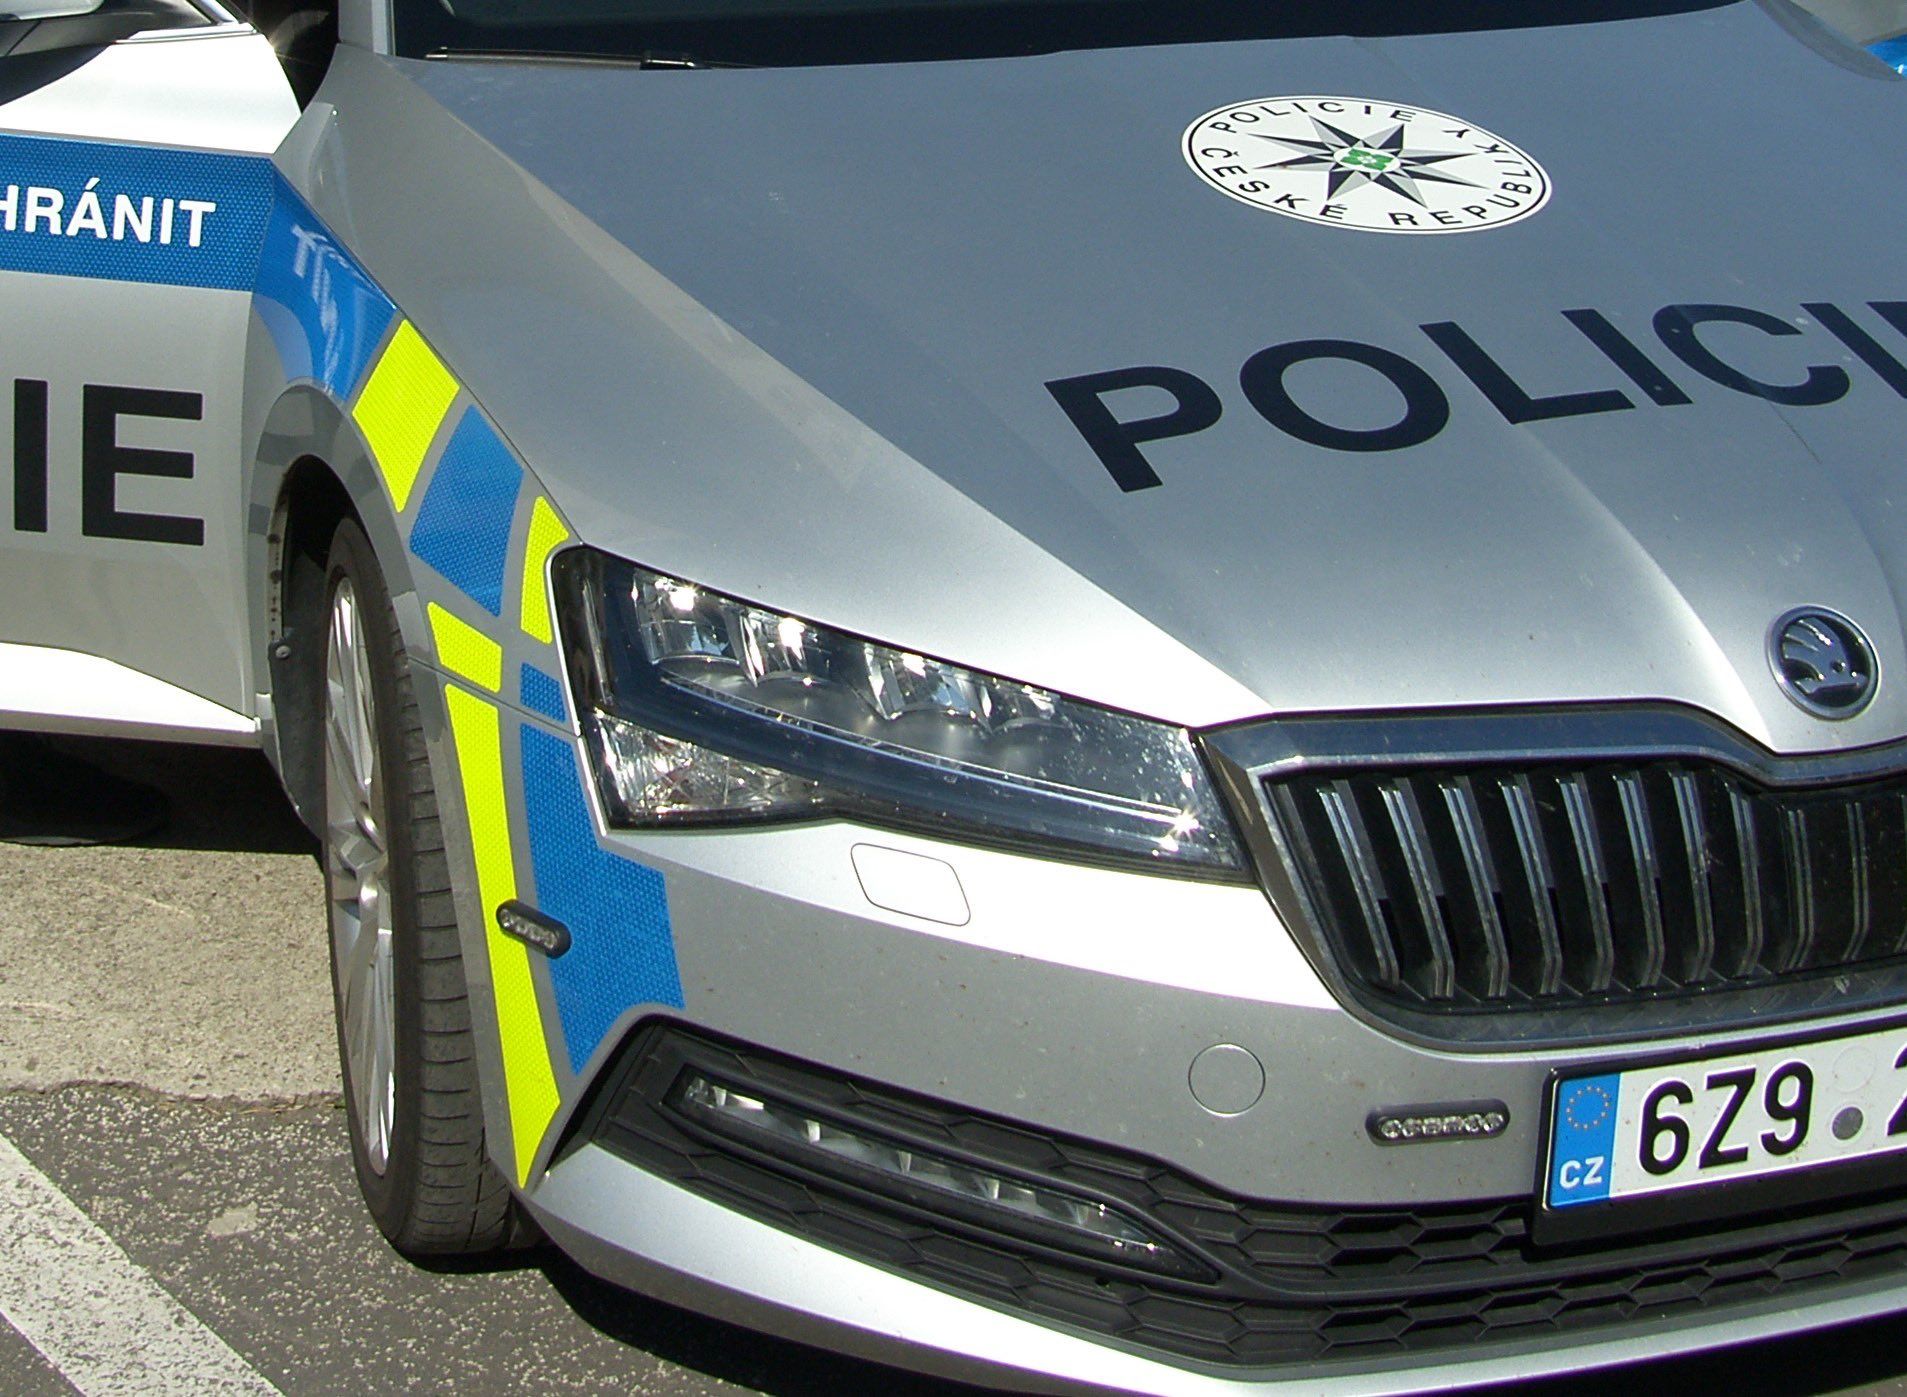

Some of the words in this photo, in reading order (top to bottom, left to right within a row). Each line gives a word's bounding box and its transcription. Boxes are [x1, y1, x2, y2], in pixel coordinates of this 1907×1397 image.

[1209, 101, 1417, 134] POLICIE
[1201, 147, 1348, 220] ČESKÉ
[1388, 126, 1533, 226] REPUBLIKY
[1043, 301, 1907, 493] POLICI
[13, 378, 205, 547] IE
[1639, 1060, 1814, 1176] 6Z9
[1559, 1156, 1603, 1189] CZ
